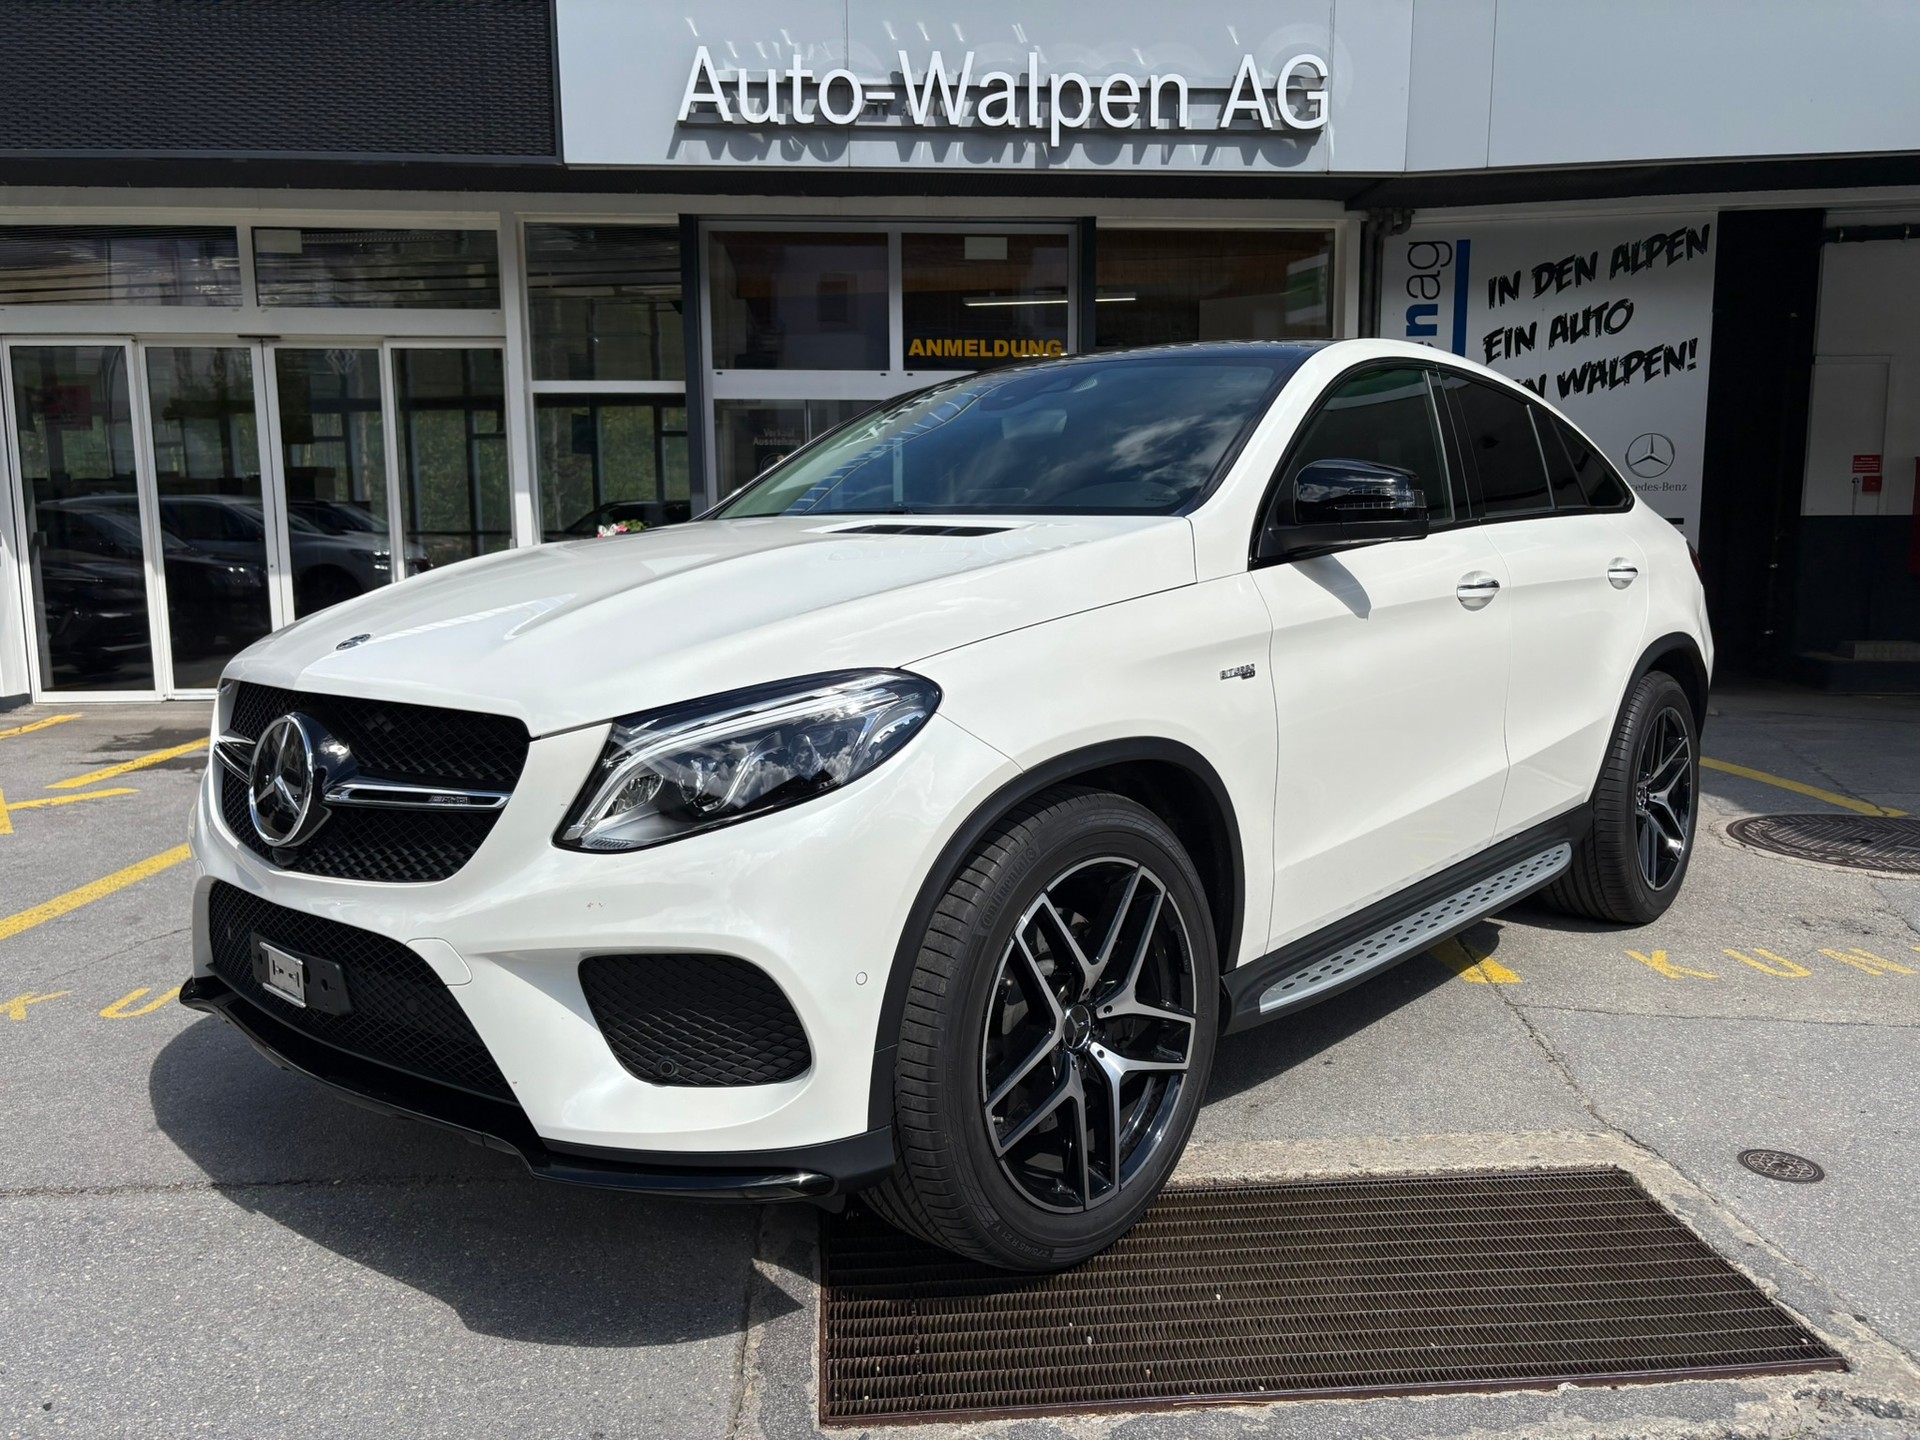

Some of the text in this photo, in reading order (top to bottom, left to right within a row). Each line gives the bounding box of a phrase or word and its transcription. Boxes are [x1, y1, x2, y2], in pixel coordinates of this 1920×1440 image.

[677, 45, 1330, 147] Auto-Walpen AG
[1487, 224, 1710, 309] IN DEN ALPEN
[908, 338, 1063, 358] ANMELDUNG
[1482, 298, 1634, 365] EIN AUTO
[1556, 338, 1698, 401] WALPEN!
